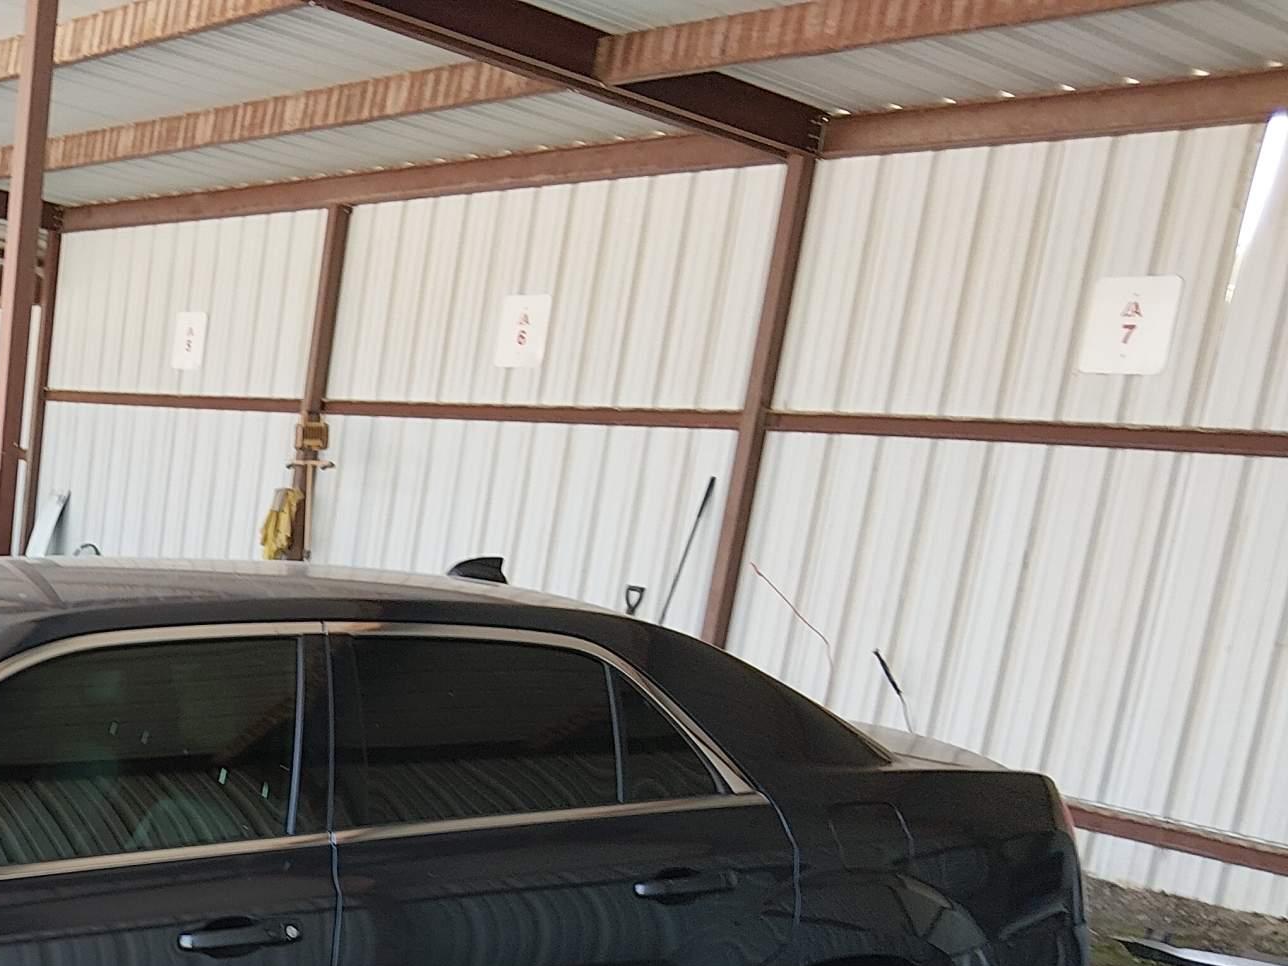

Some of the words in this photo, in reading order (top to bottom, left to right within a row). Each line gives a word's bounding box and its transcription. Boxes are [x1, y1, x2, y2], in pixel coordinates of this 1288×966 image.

[1119, 300, 1143, 318] A
[516, 329, 528, 346] 6
[1121, 323, 1138, 345] 7
